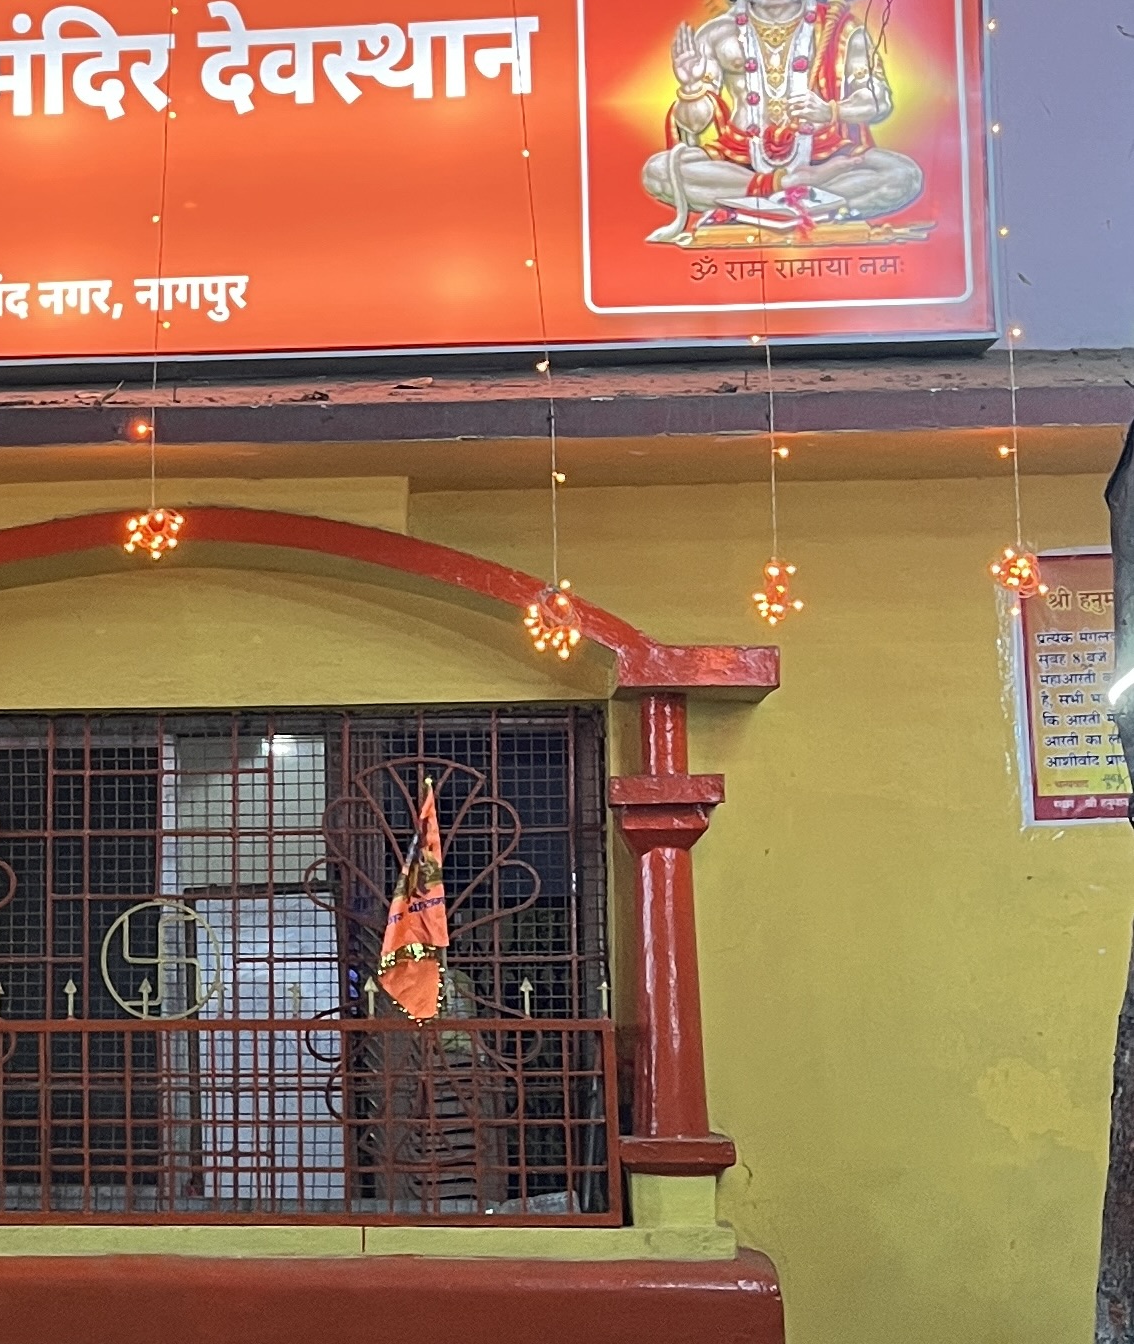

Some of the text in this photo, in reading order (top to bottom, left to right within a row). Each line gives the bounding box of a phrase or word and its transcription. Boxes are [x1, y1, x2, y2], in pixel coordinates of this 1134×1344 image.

[197, 0, 539, 115] देवस्थान
[690, 255, 904, 281] ॐ राम रामाया नमः
[38, 279, 123, 320] नगर,
[134, 275, 249, 323] नागपुर
